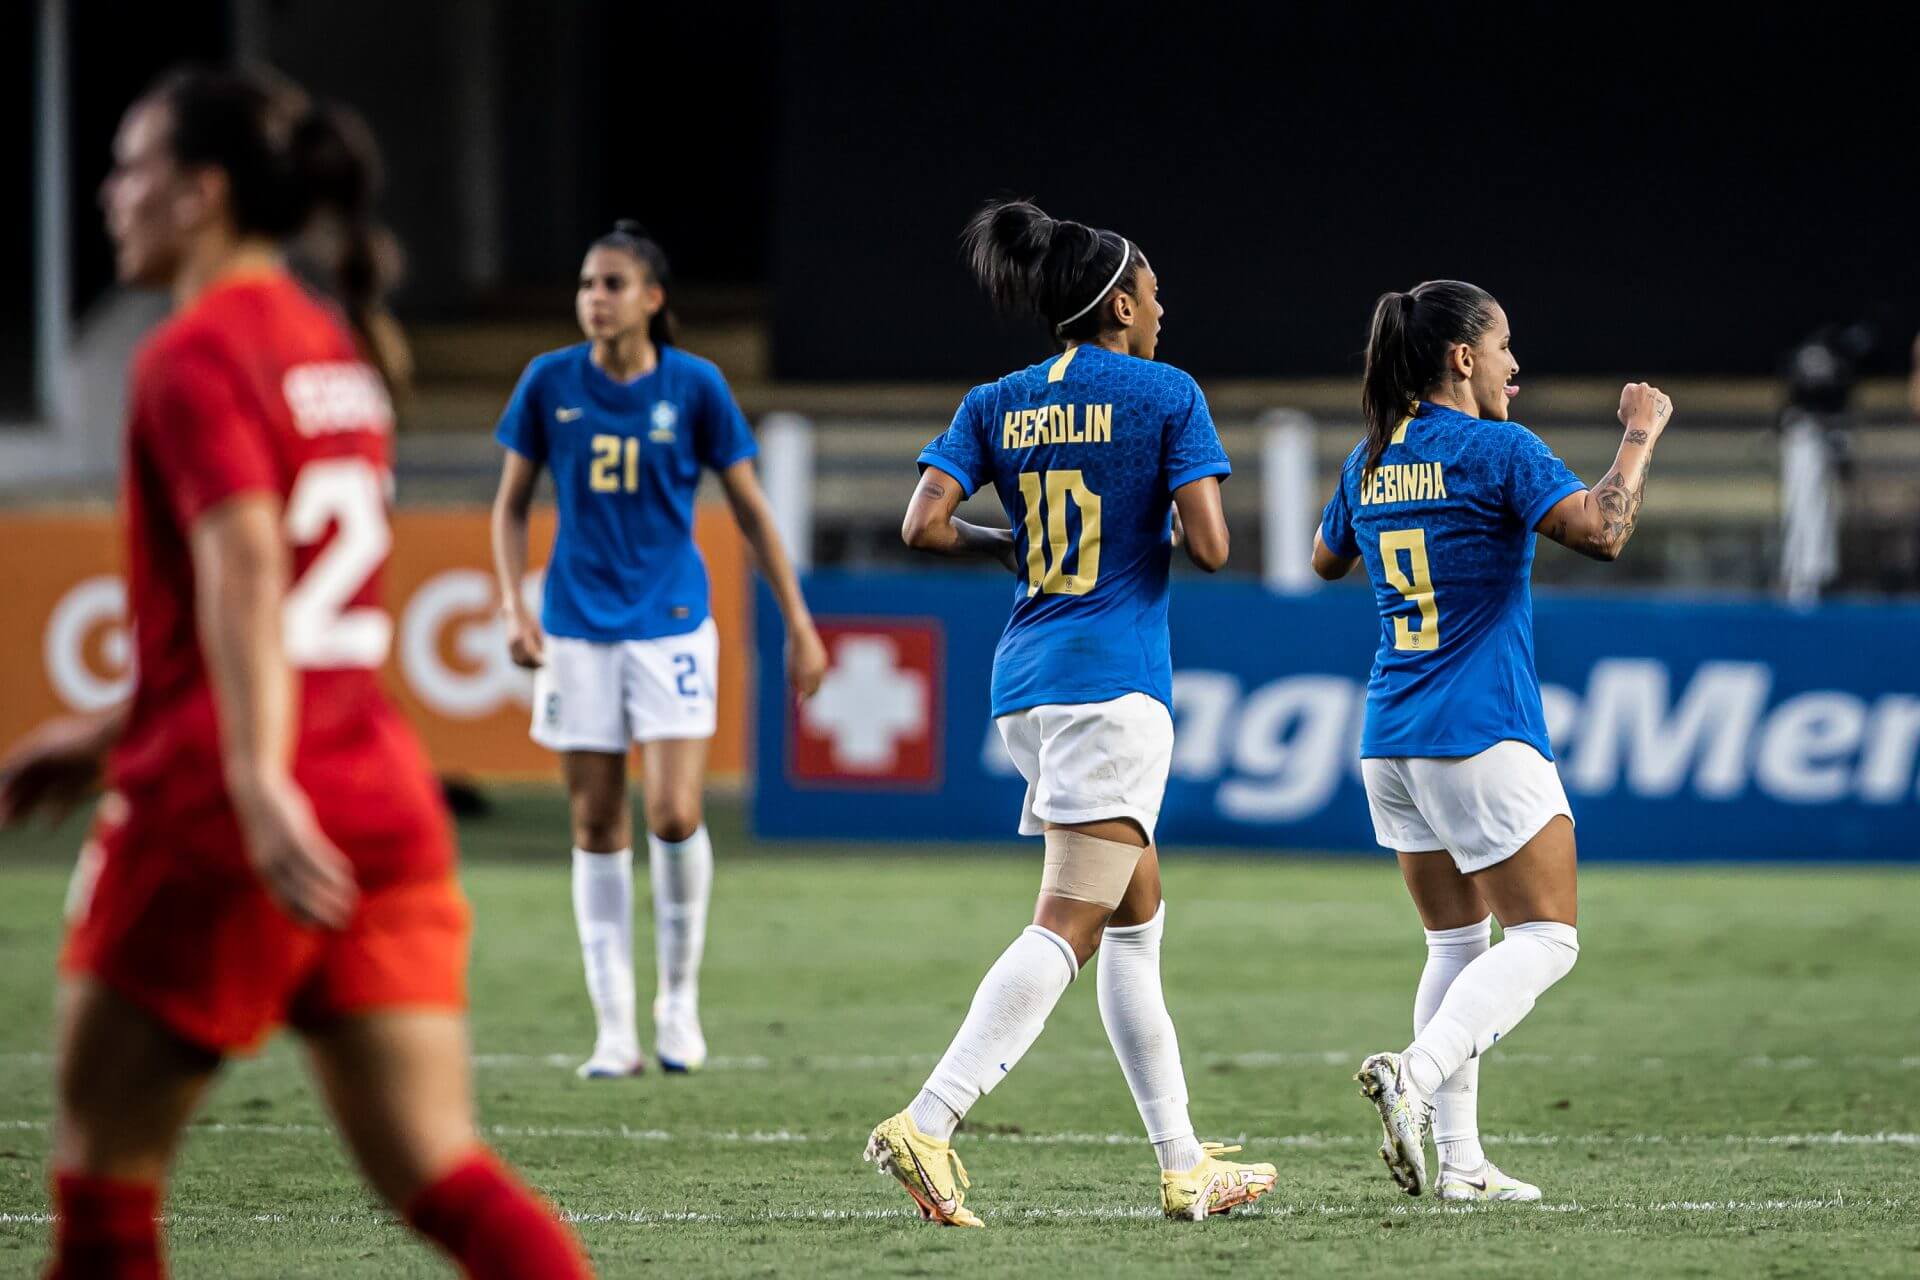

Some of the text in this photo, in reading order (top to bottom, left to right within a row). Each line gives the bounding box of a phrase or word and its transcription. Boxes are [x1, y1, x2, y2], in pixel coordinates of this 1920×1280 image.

[1002, 403, 1113, 449] KEROLIN
[589, 433, 640, 493] 21
[1360, 461, 1447, 506] DEBINHA
[283, 456, 396, 667] 2
[1018, 469, 1102, 598] 10
[1379, 528, 1440, 651] 9
[672, 652, 698, 697] 2
